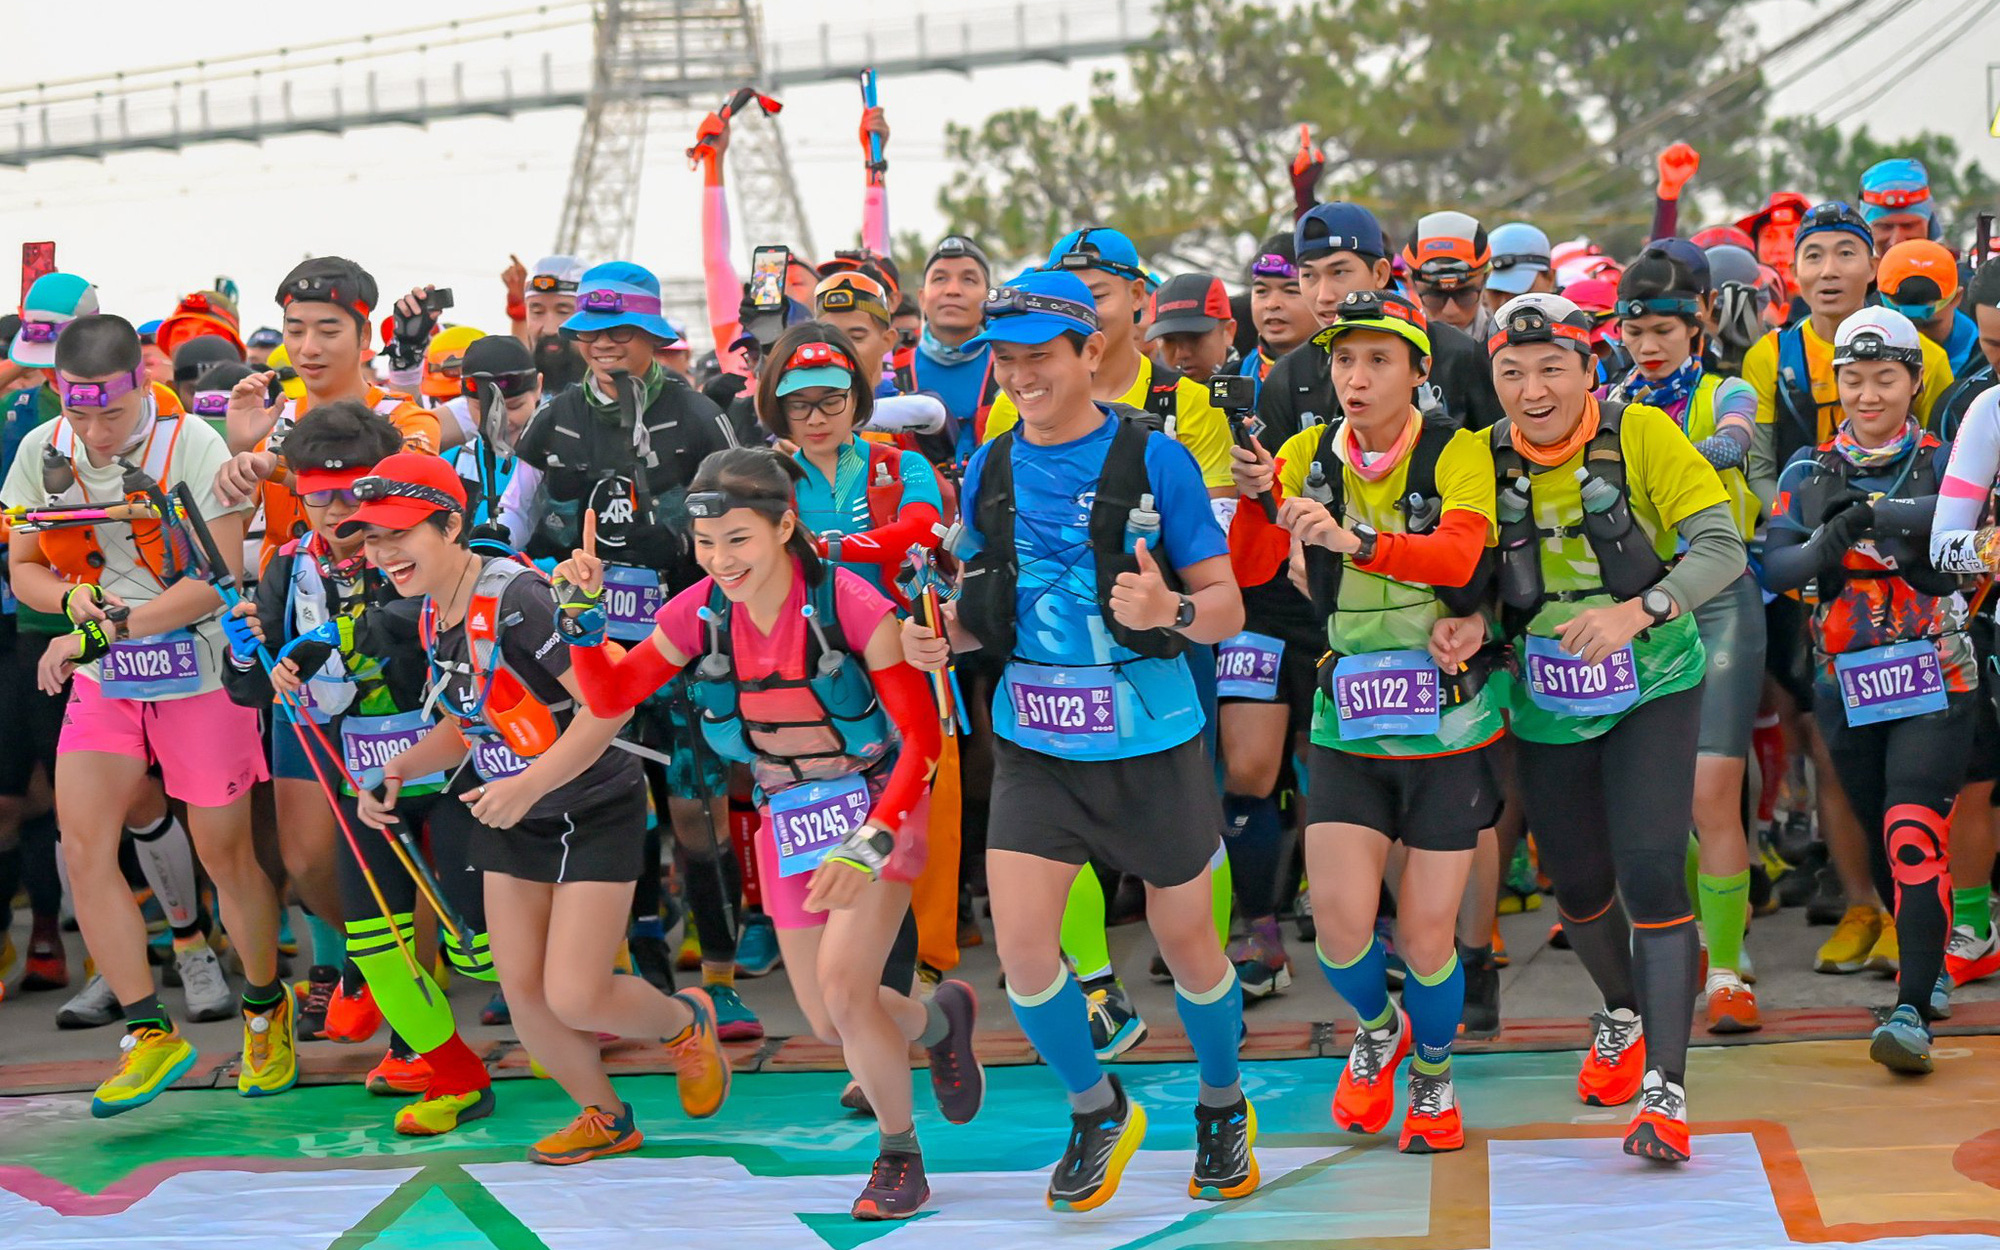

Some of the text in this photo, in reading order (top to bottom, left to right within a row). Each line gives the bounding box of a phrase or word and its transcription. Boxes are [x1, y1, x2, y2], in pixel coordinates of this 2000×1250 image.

[85, 620, 106, 648] LEKI
[115, 649, 172, 677] S1028
[1544, 662, 1607, 694] S1120
[1350, 677, 1408, 712] S1122
[1857, 664, 1916, 700] S1072
[1026, 691, 1087, 727] S1123
[483, 745, 528, 773] S122
[789, 804, 850, 847] S1245
